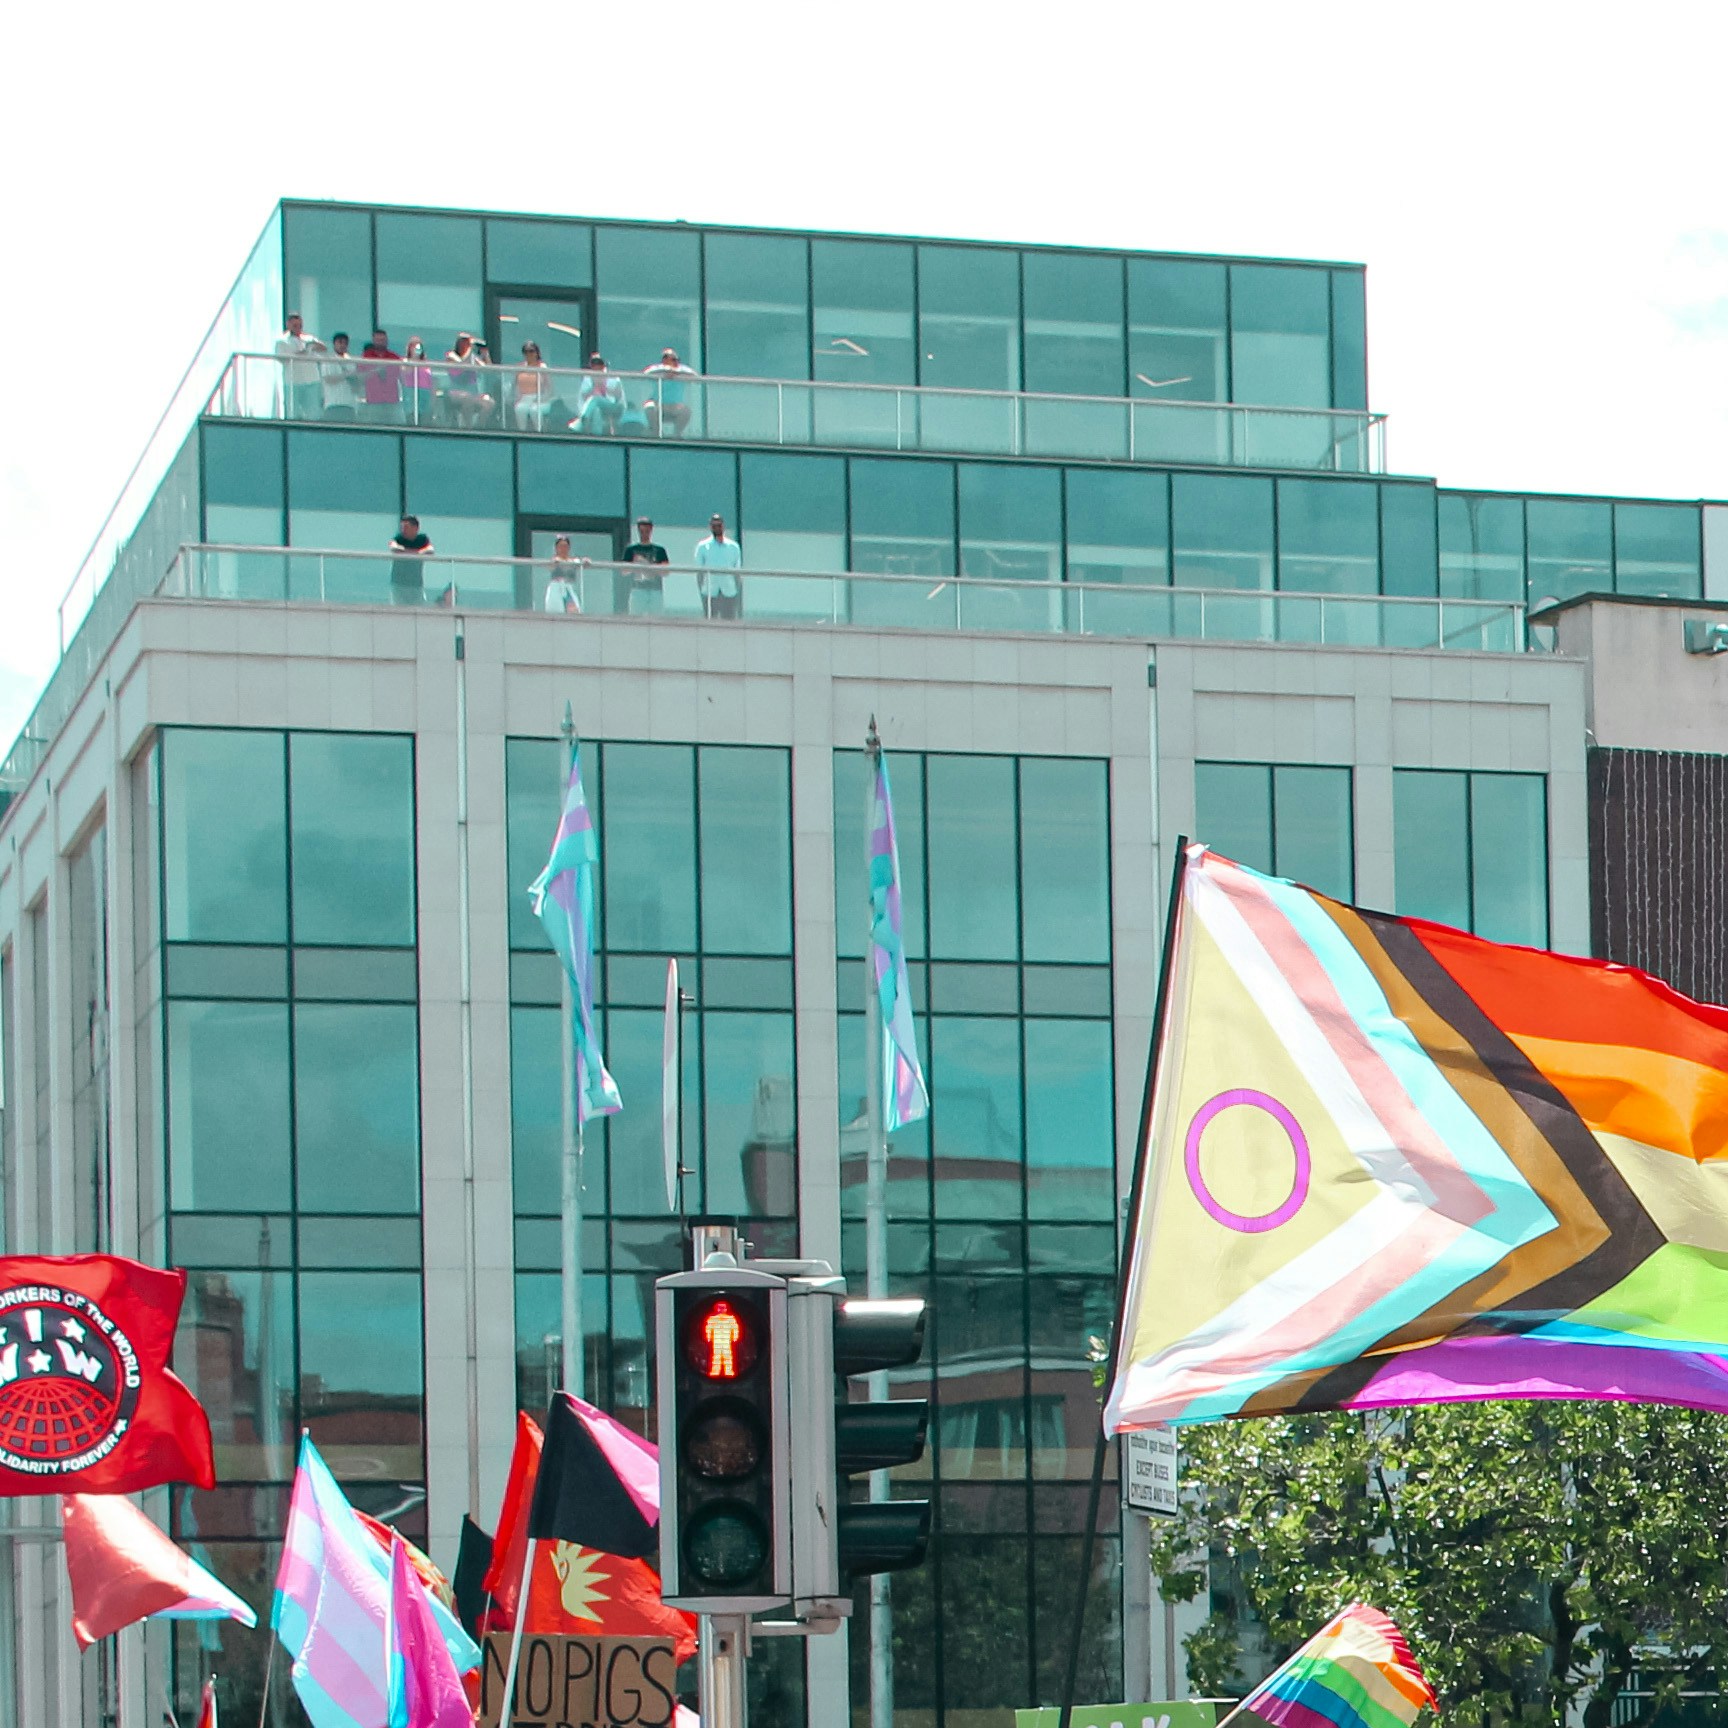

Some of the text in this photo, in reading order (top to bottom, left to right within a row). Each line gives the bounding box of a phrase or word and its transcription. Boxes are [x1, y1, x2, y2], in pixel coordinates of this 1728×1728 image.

[24, 1309, 43, 1343] I
[64, 1293, 86, 1308] OF
[88, 1303, 115, 1334] THE
[111, 1329, 141, 1388] WORLD
[0, 1433, 119, 1474] LIDARITY FOREVER
[481, 1636, 675, 1726] NO PIGS
